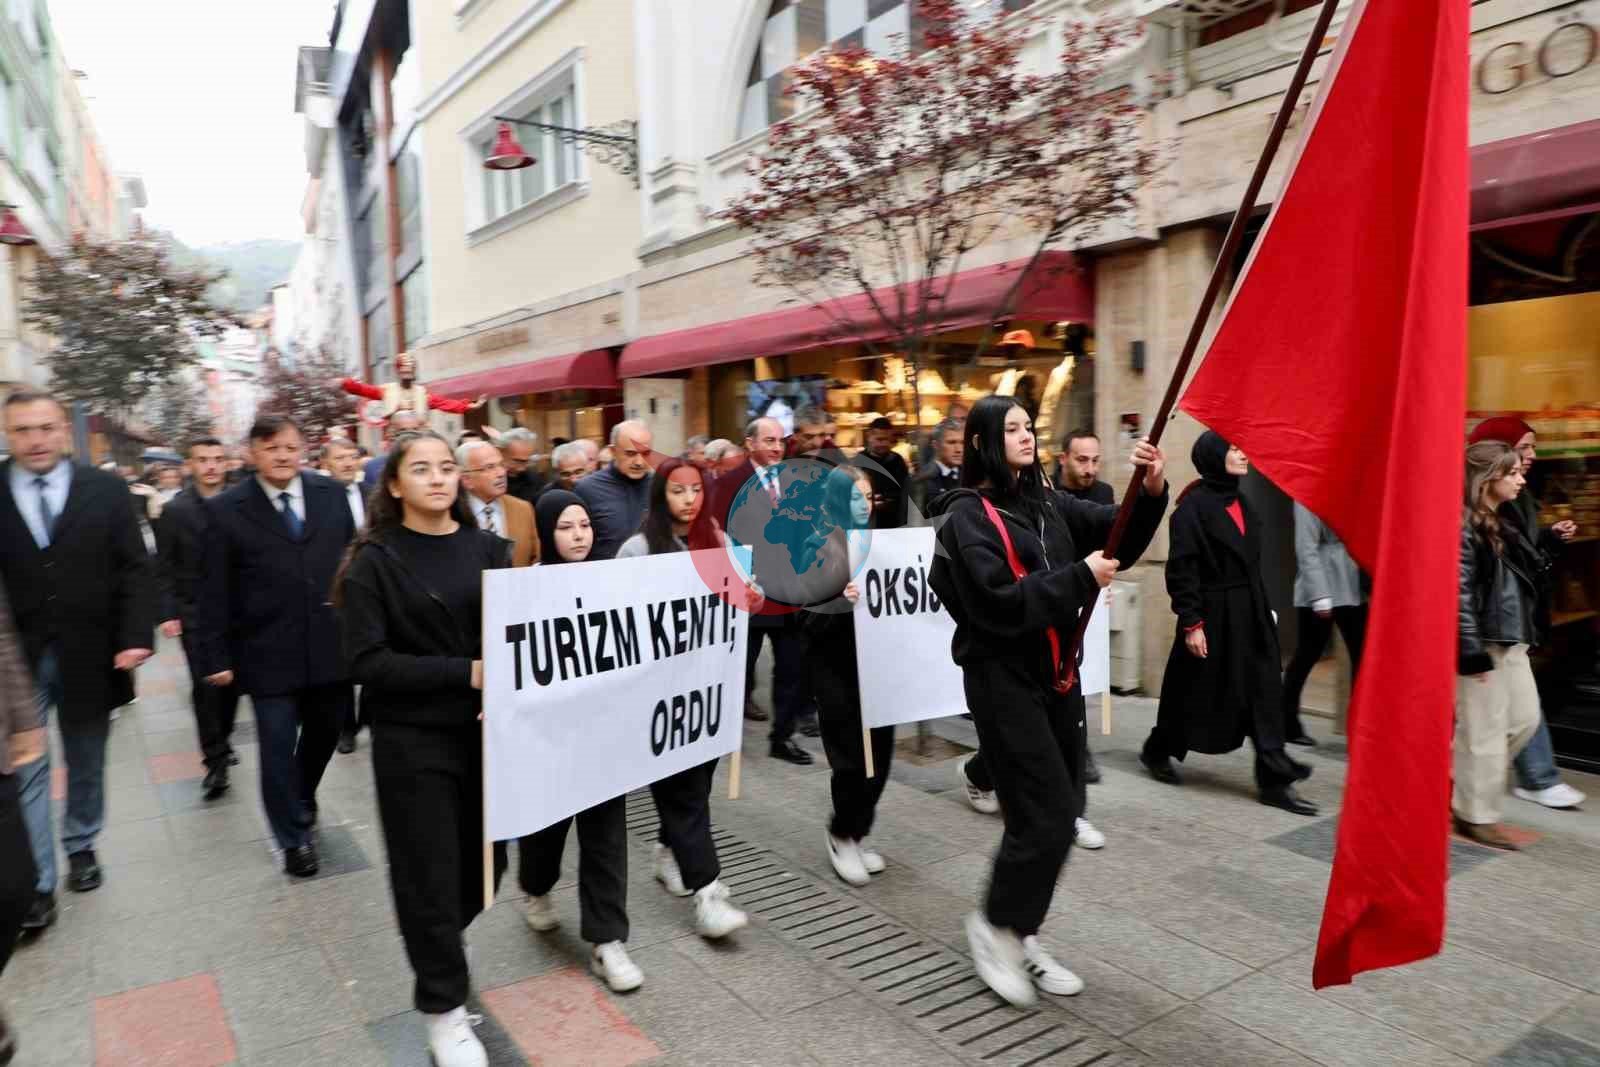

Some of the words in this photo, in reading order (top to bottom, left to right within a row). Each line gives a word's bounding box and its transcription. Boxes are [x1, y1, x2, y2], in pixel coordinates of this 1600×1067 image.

[505, 597, 641, 691] TURİZM
[647, 577, 736, 660] KENTİ;
[651, 683, 723, 757] ORDU
